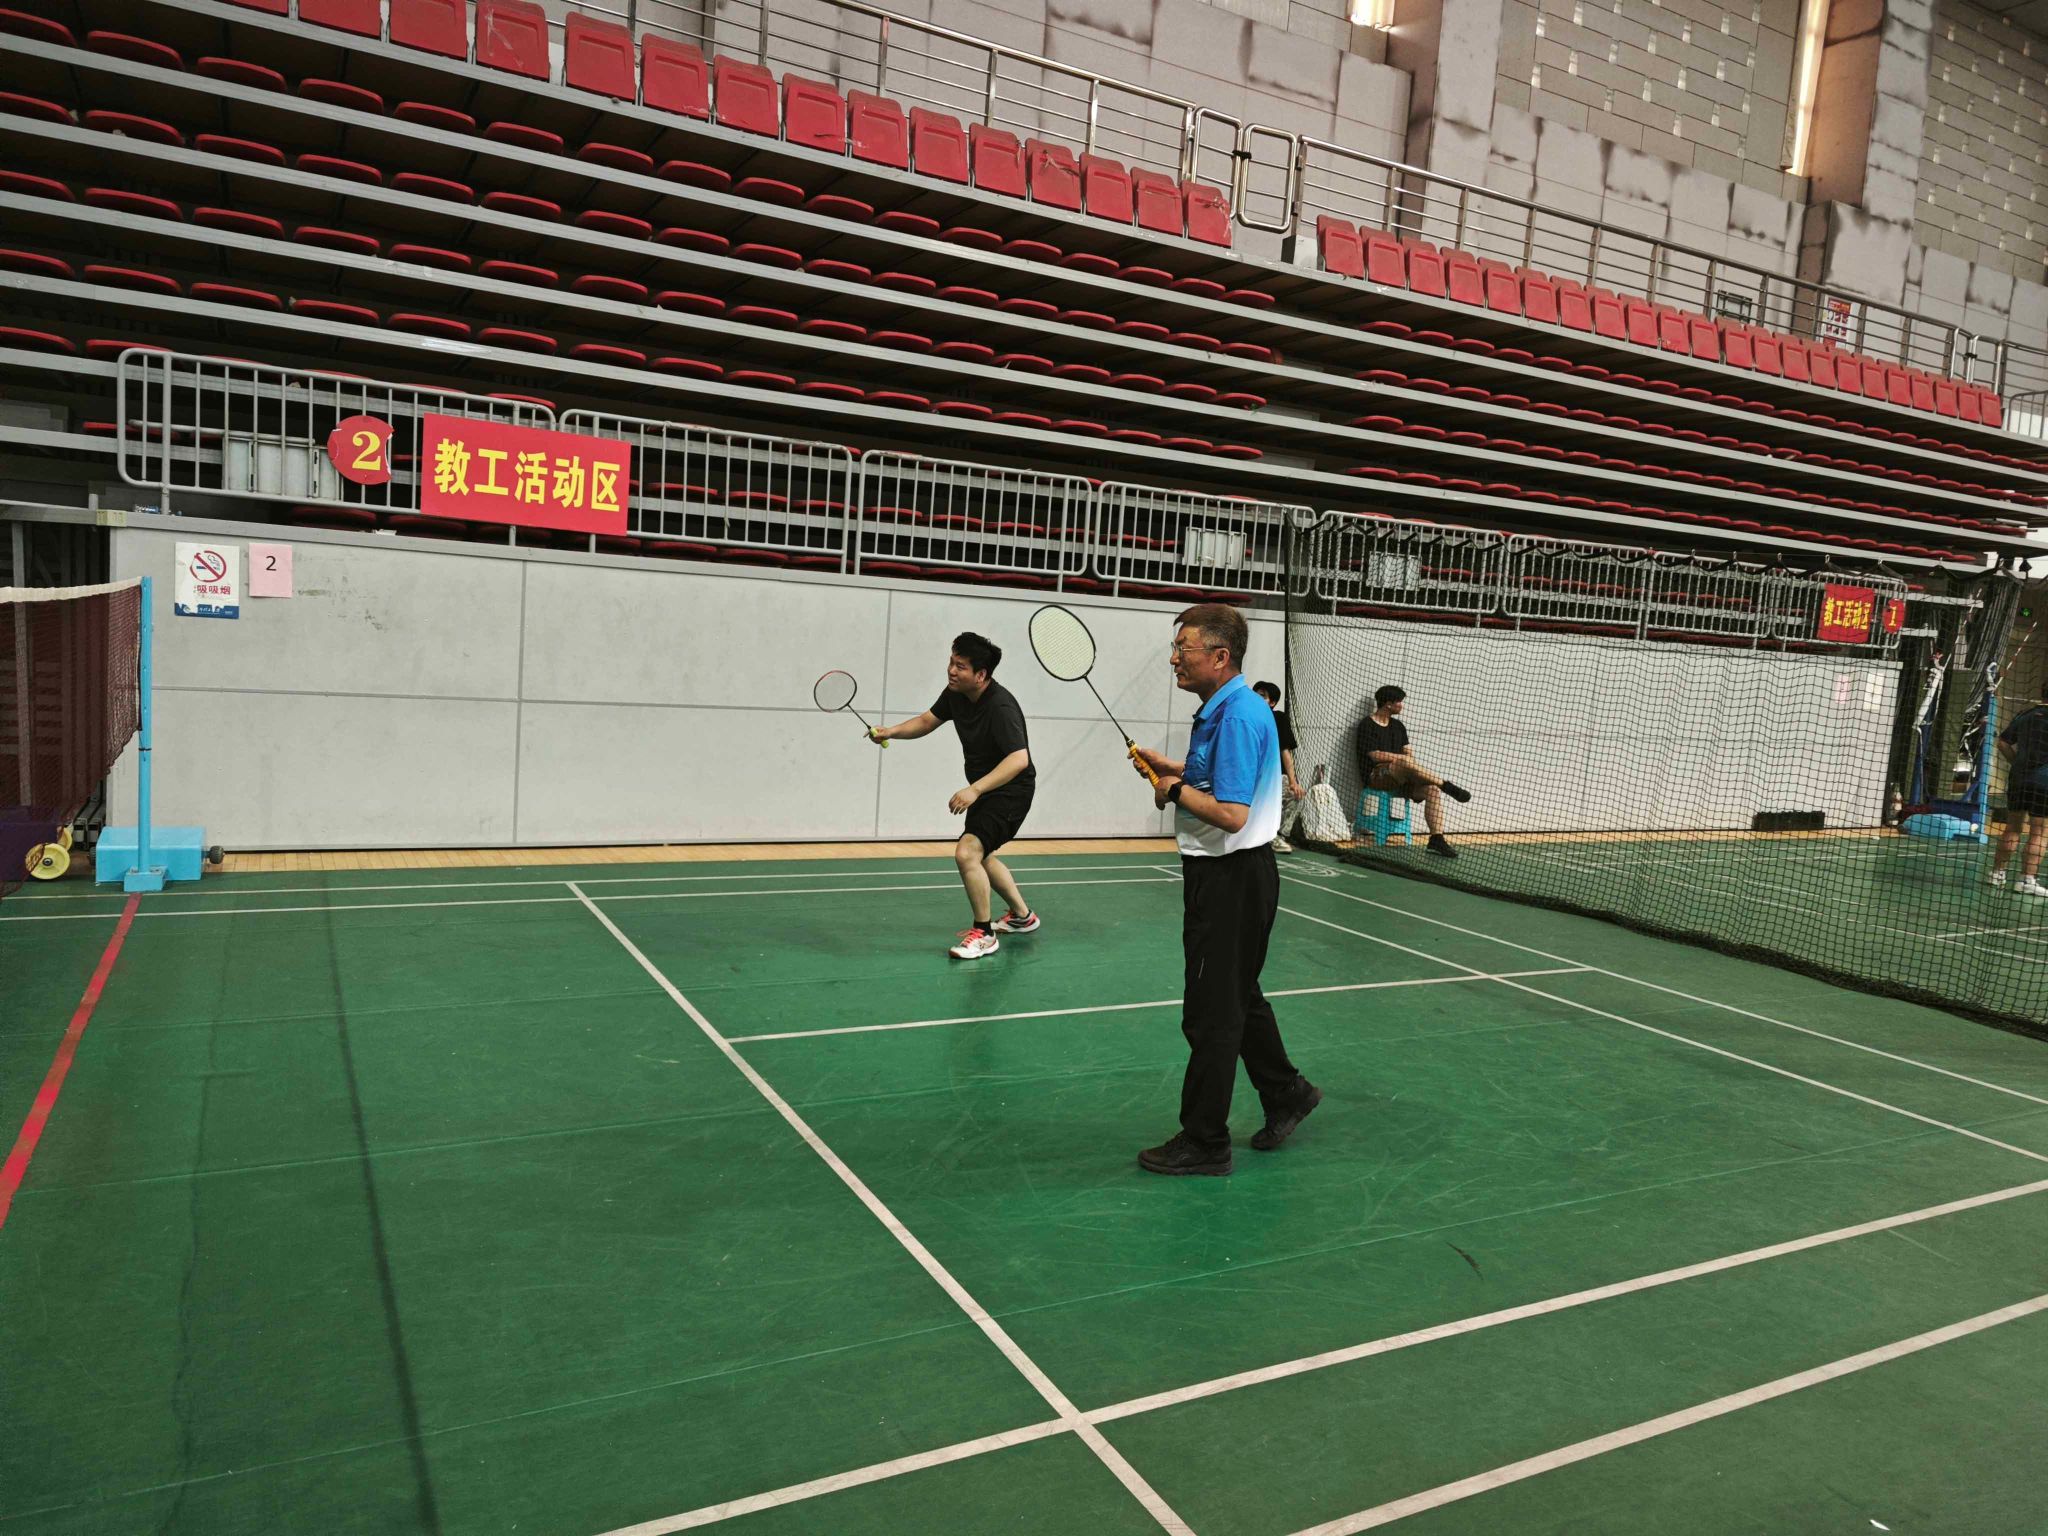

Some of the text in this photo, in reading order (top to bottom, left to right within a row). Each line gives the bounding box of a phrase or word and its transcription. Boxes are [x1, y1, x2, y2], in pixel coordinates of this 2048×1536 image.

[352, 430, 382, 471] 2
[434, 438, 621, 512] 教工活动区
[266, 556, 276, 571] 2
[1888, 607, 1897, 626] 1
